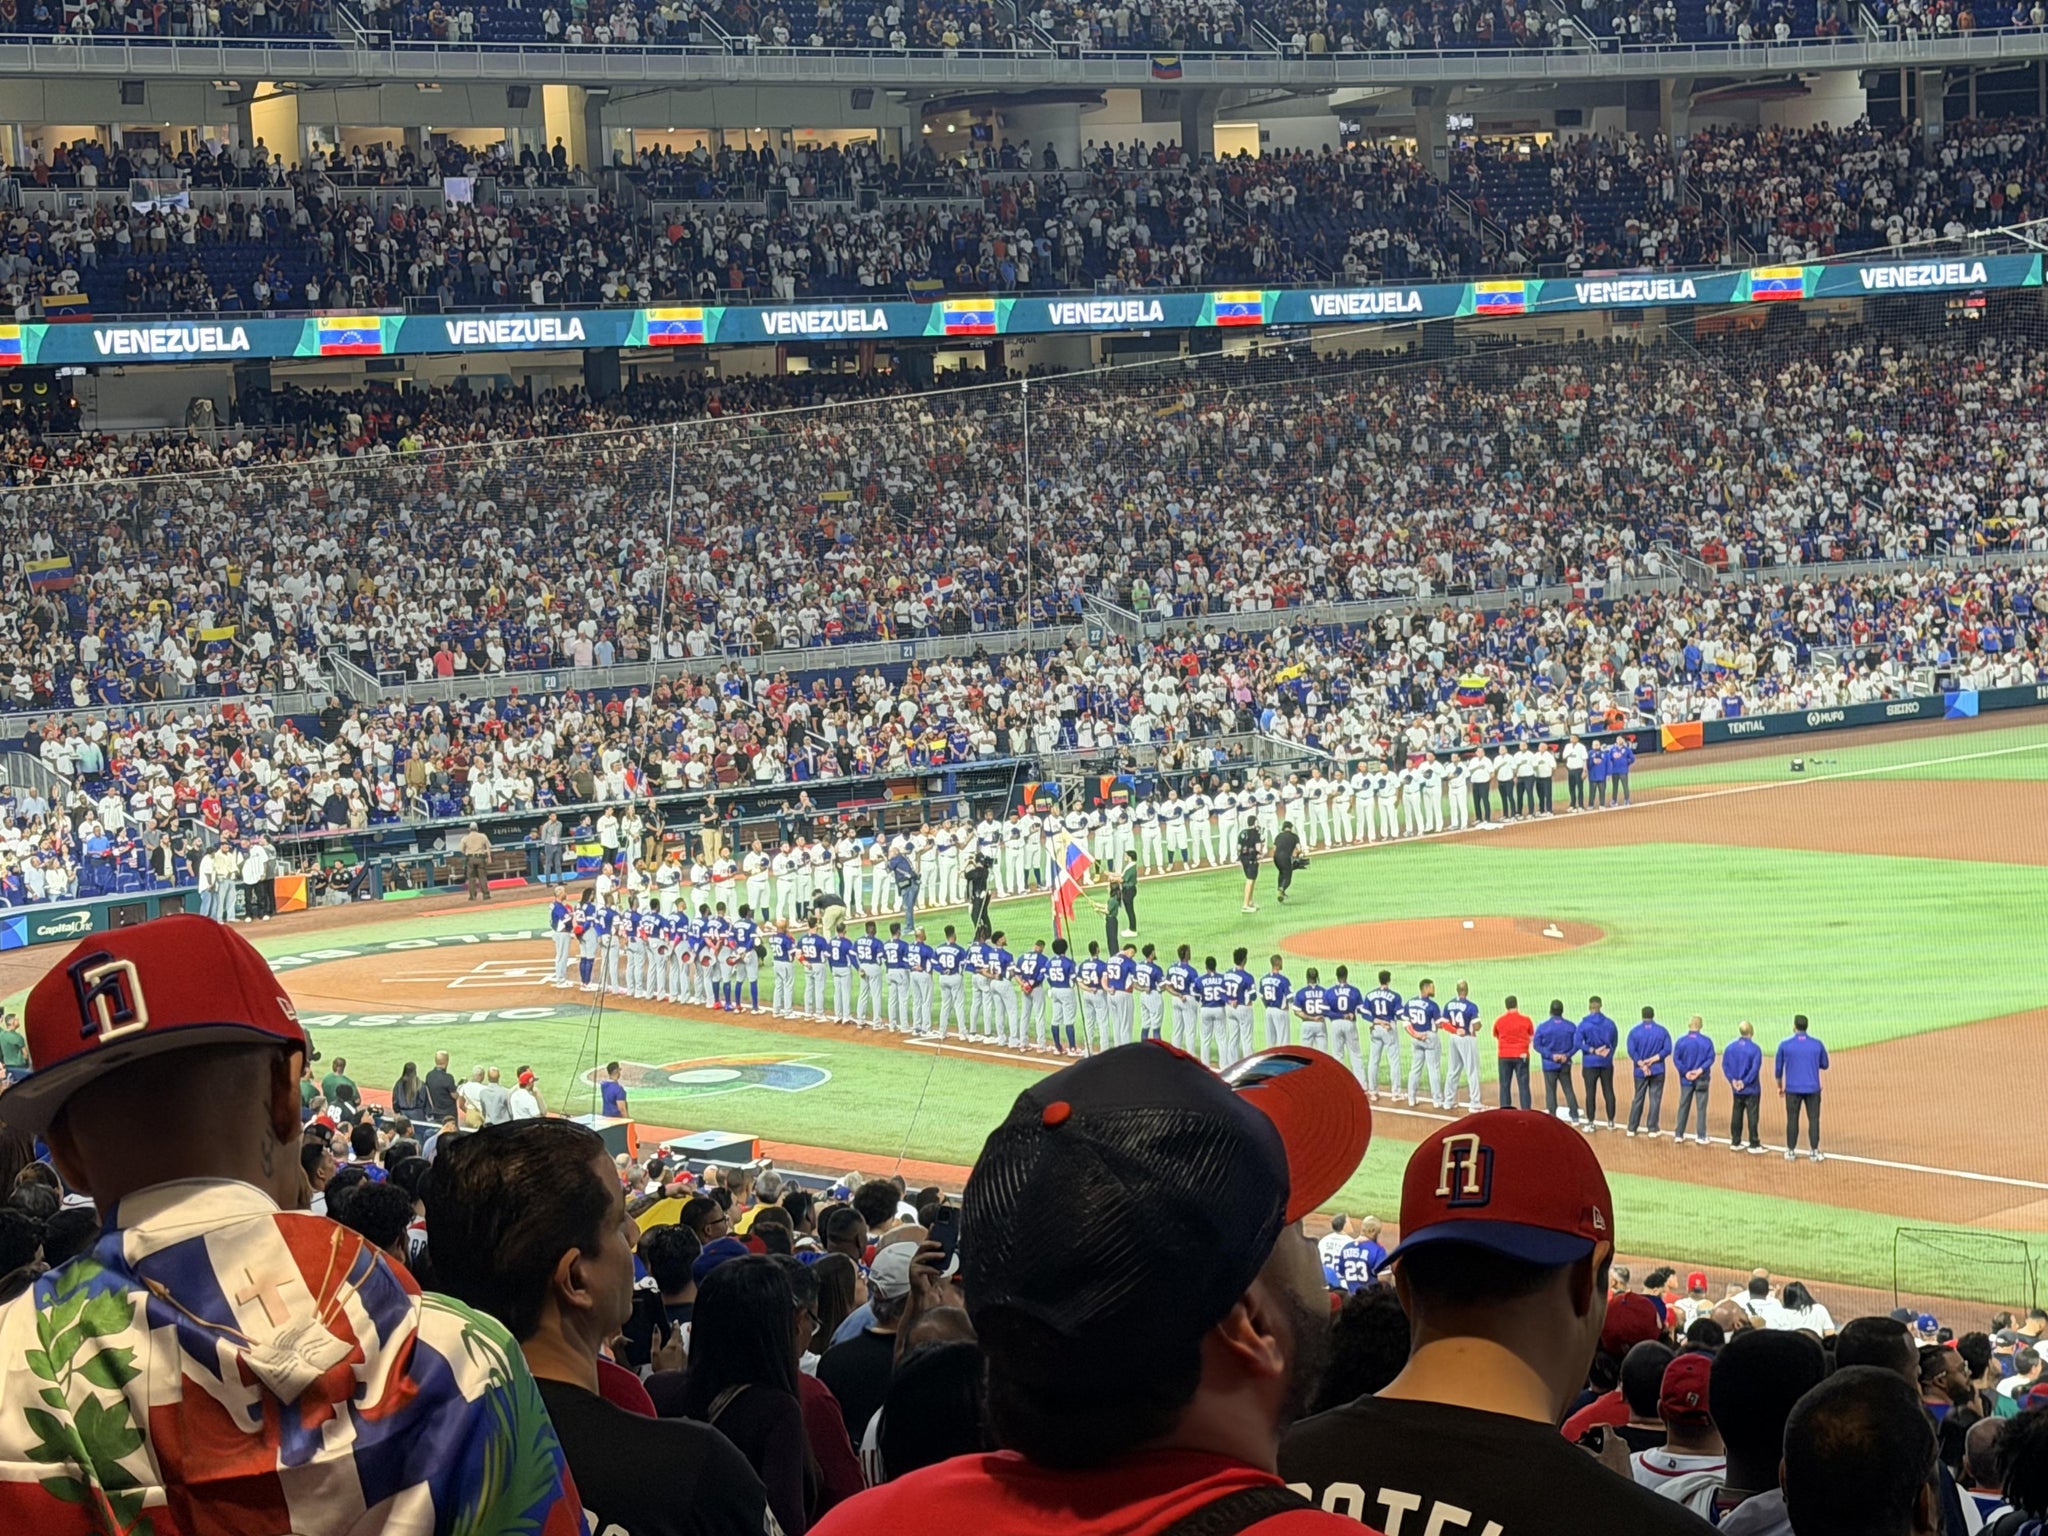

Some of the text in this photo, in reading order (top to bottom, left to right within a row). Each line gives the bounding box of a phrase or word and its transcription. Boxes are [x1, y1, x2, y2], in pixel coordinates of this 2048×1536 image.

[1860, 263, 1987, 289] VENEZUELA
[1576, 279, 1697, 304] VENEZUELA
[1311, 291, 1423, 316] VENEZUELA
[1049, 301, 1164, 326] VENEZUELA
[762, 309, 889, 335] VENEZUELA
[446, 318, 586, 345] VENEZUELA
[94, 327, 250, 355] VENEZUELA
[903, 646, 913, 658] 21
[544, 676, 557, 688] 20
[1887, 701, 1920, 716] SEIKO
[1820, 710, 1845, 723] MUFG
[1728, 720, 1765, 734] TENTIAL
[737, 928, 745, 942] 2
[802, 945, 817, 958] 99
[832, 947, 840, 961] 8
[857, 945, 873, 960] 52
[886, 950, 898, 963] 12
[908, 953, 921, 966] 29
[939, 955, 955, 968] 48
[1021, 960, 1037, 975] 47
[1050, 967, 1065, 982] 65
[1107, 965, 1121, 980] 53
[1081, 971, 1098, 984] 54
[1170, 974, 1185, 990] 43
[1337, 996, 1348, 1011] 0
[1375, 1000, 1388, 1016] 11
[1409, 1009, 1426, 1025] 50
[1450, 1011, 1465, 1027] 14
[327, 1104, 342, 1123] 88
[1344, 1260, 1368, 1282] 23
